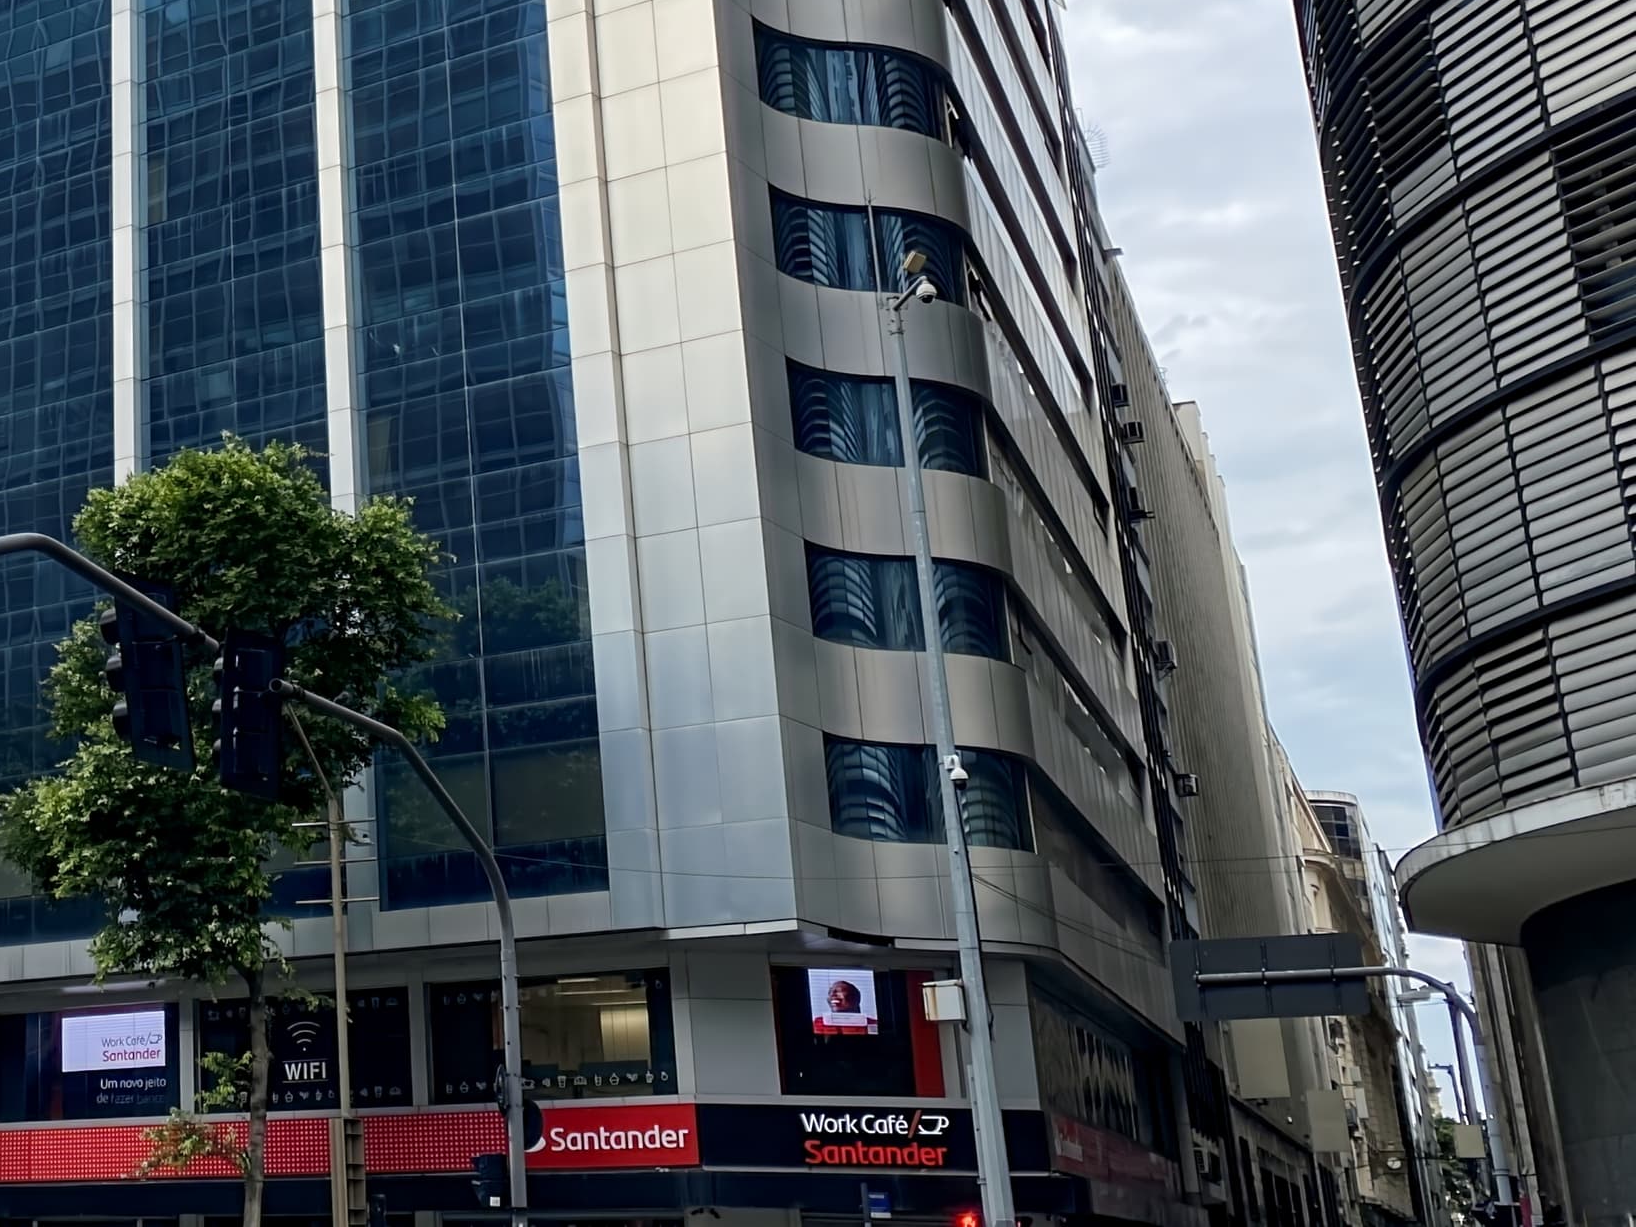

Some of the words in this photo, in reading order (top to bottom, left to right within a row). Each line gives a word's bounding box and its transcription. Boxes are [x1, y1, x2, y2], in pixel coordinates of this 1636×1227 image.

[101, 1036, 124, 1048] Work
[102, 1048, 162, 1062] Santander
[284, 1062, 326, 1080] WIFI
[100, 1078, 118, 1090] Um
[119, 1078, 144, 1089] novo
[144, 1077, 167, 1091] jeito
[95, 1092, 109, 1104] de
[799, 1113, 860, 1134] Work
[550, 1124, 689, 1152] Santander
[803, 1139, 948, 1166] Santander
